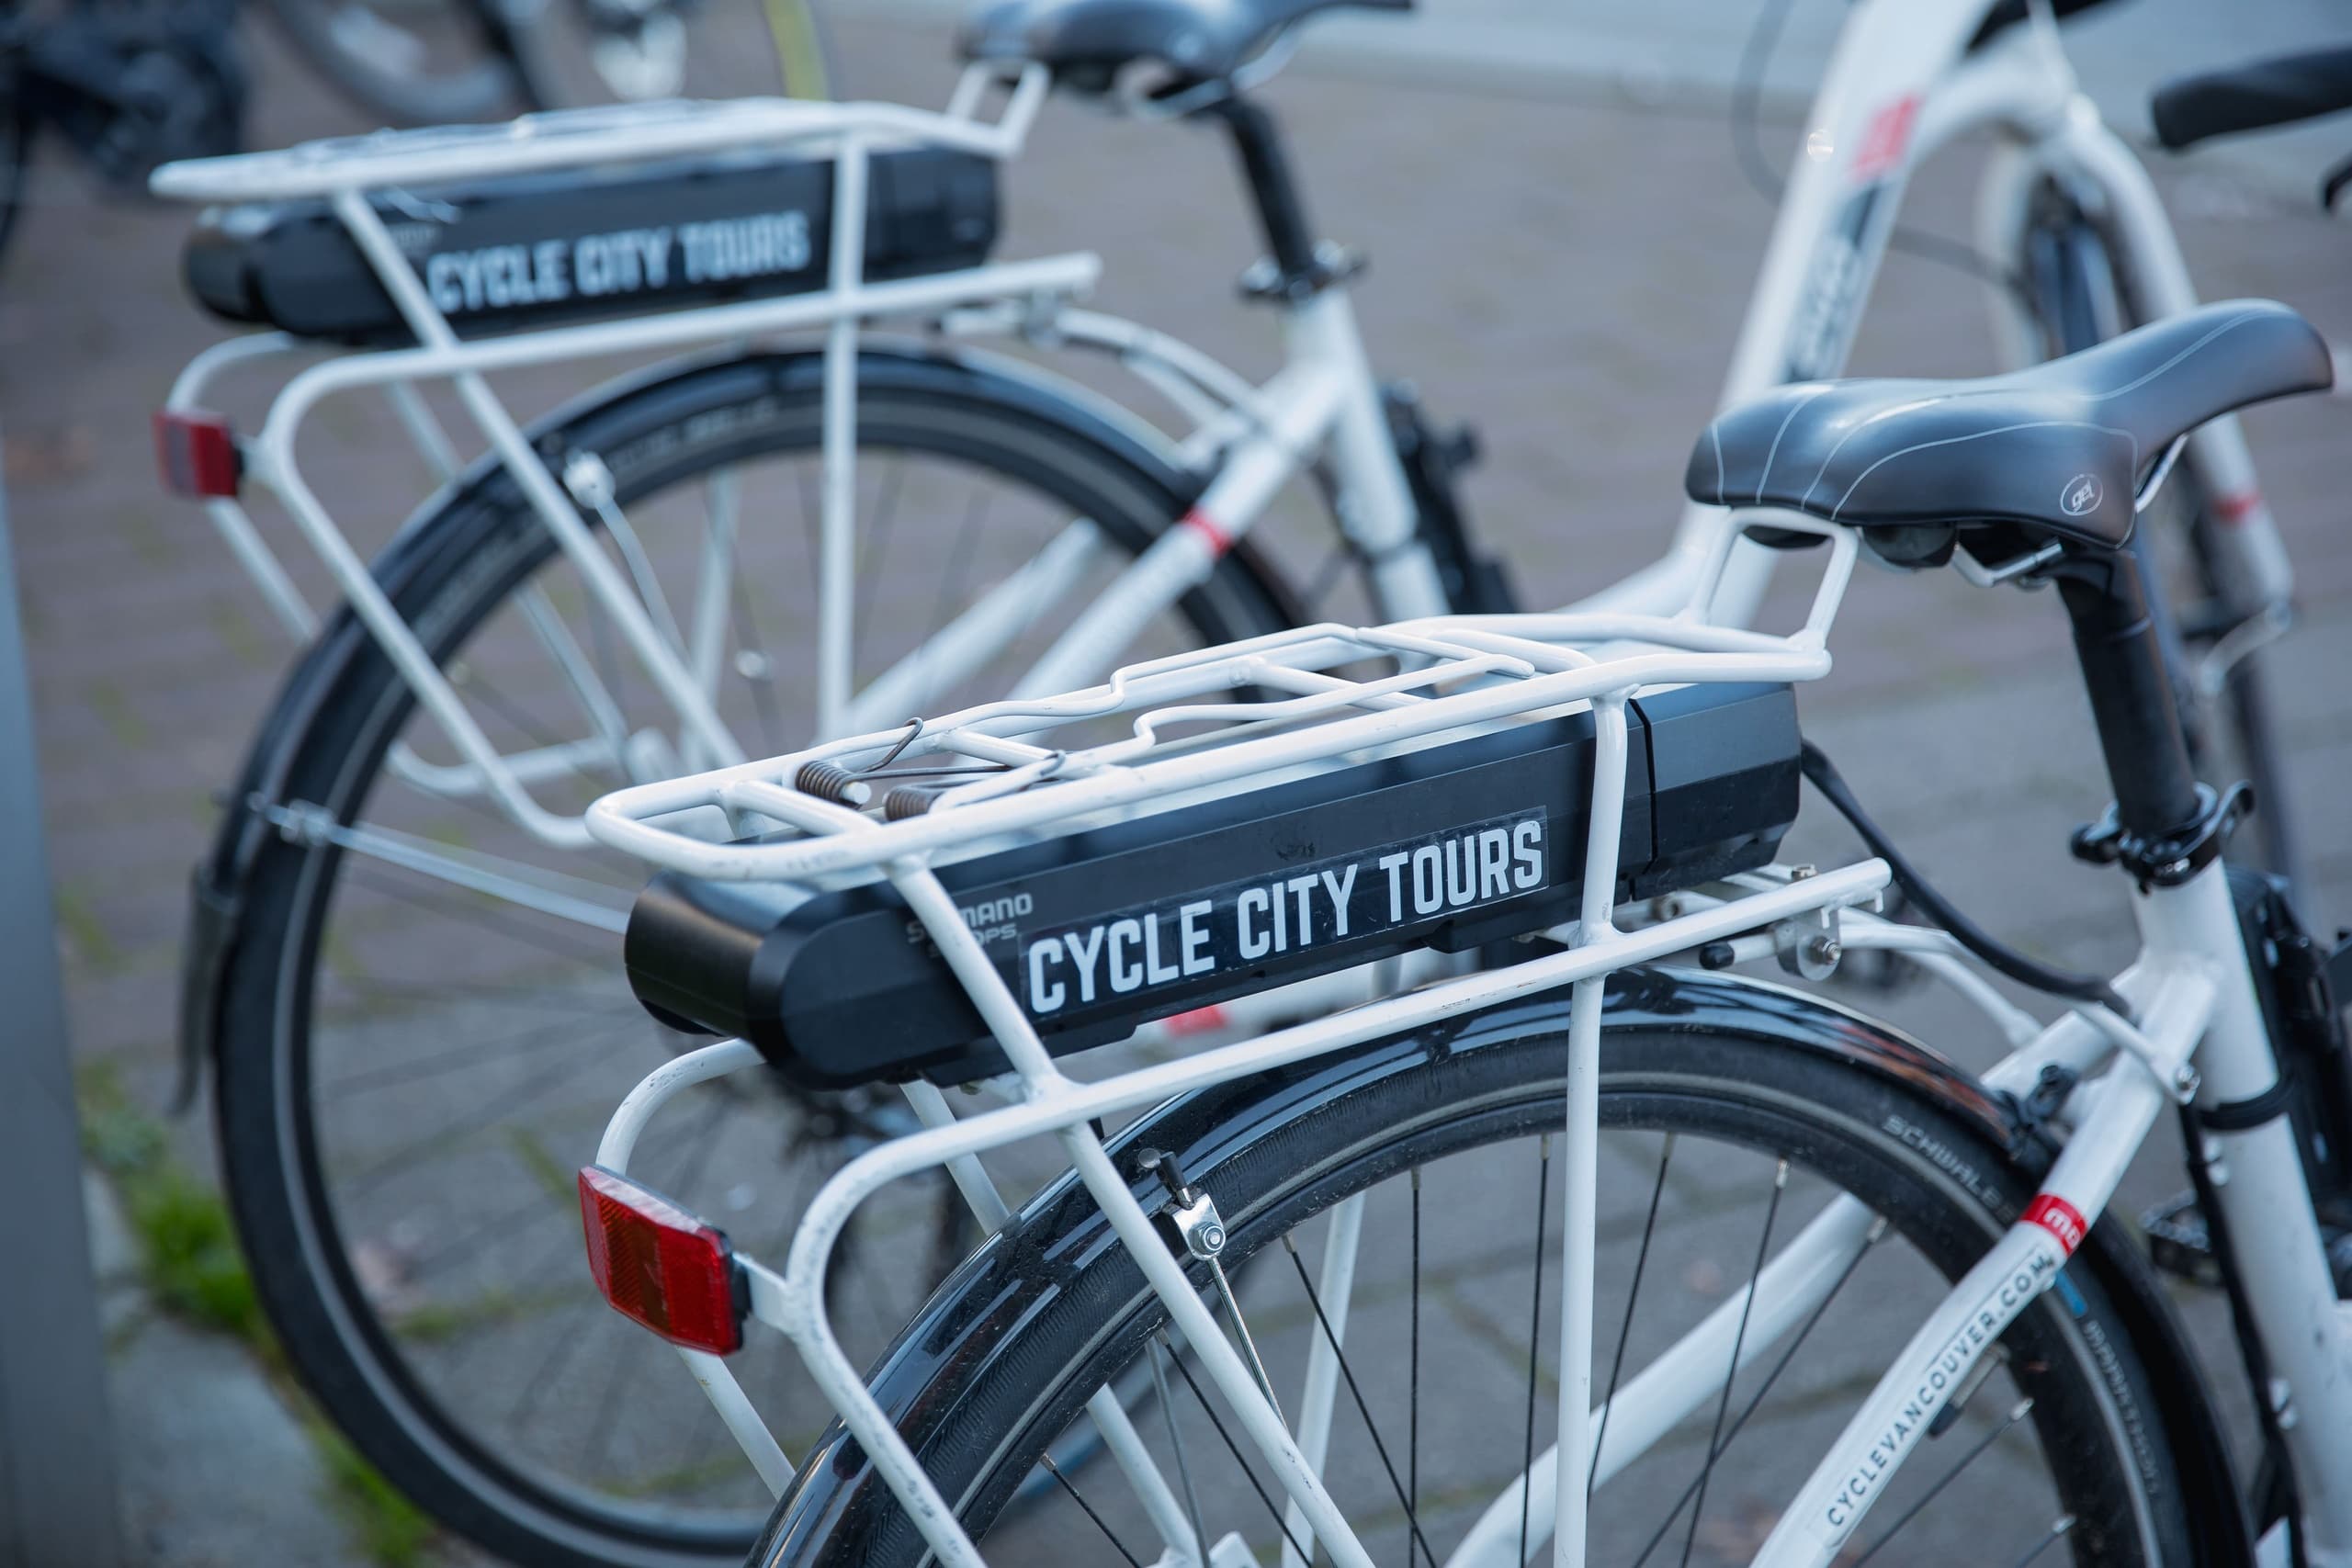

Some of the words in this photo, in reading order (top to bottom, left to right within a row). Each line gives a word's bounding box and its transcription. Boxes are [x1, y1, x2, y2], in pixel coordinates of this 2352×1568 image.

[427, 239, 571, 313] CYCLE
[574, 226, 673, 296] CITY
[676, 209, 811, 284] TOURS
[2072, 478, 2095, 514] gel
[905, 892, 1034, 944] SMANO
[1028, 899, 1215, 1013] CYCLE
[1238, 863, 1358, 960] CITY
[1379, 820, 1543, 923] TOURS
[1827, 1255, 2054, 1527] CYCLEVANCOUVER.COM
